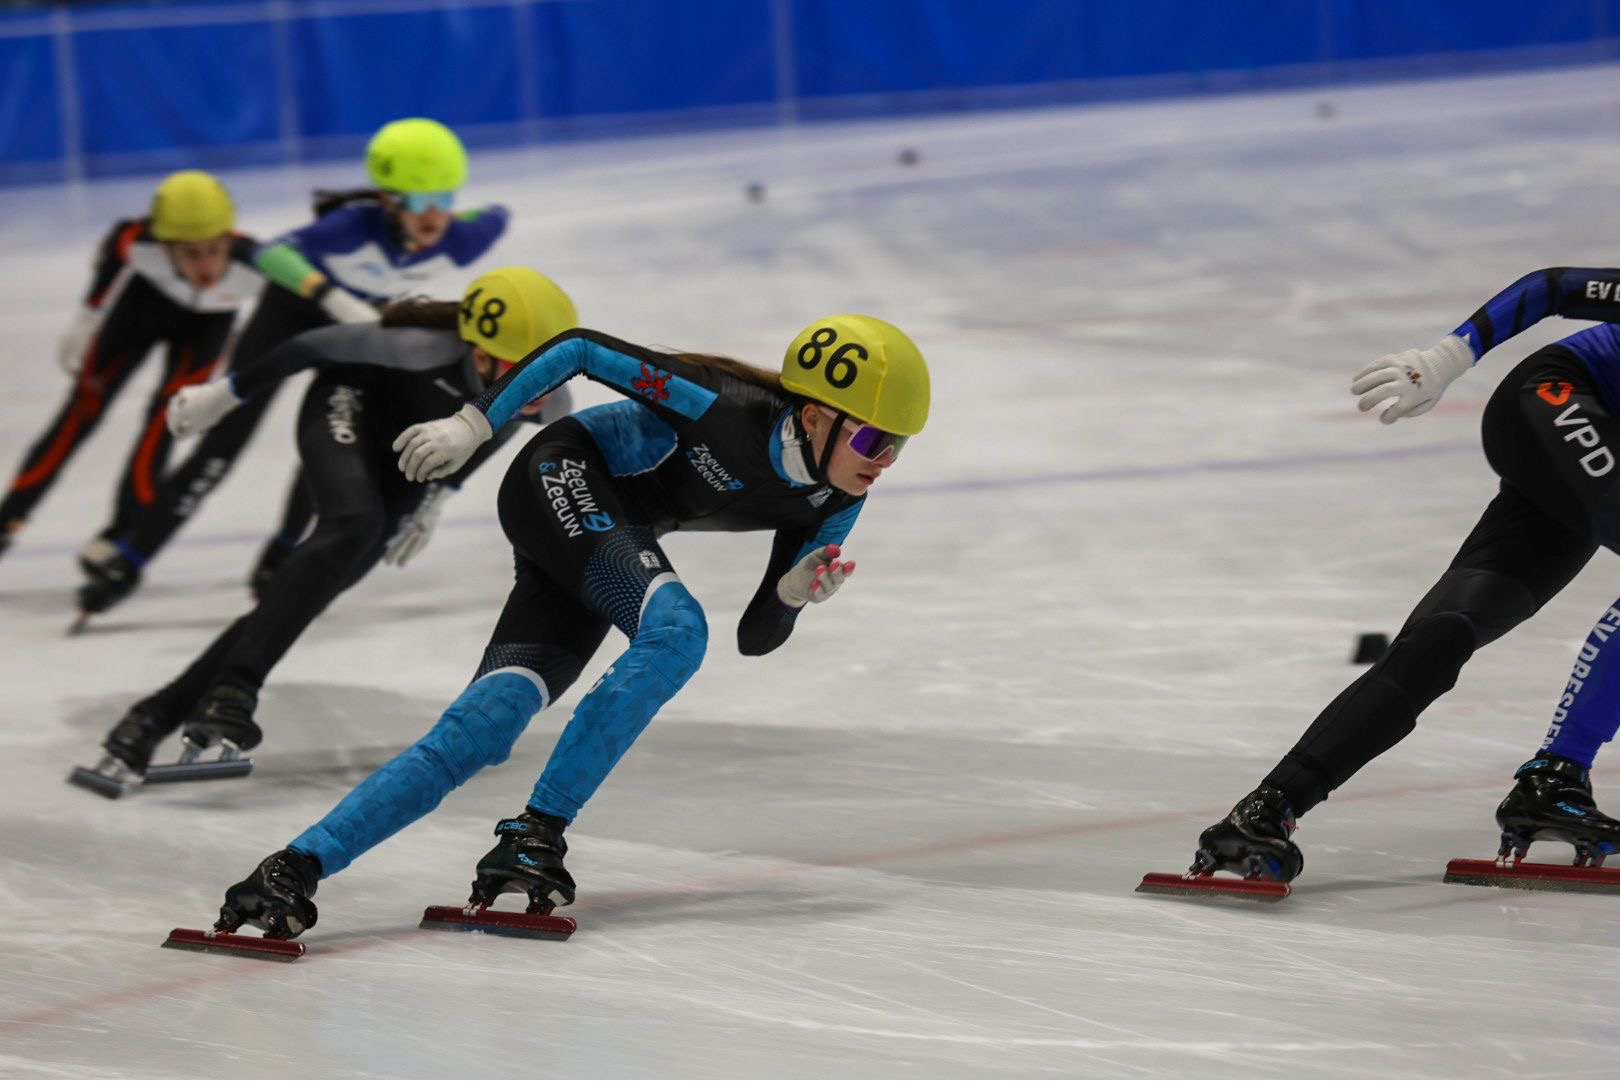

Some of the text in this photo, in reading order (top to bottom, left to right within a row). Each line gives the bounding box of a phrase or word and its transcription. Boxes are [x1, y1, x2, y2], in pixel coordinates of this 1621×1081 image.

[460, 287, 506, 339] 48
[1585, 280, 1613, 300] EV
[797, 327, 869, 389] 86
[692, 443, 732, 482] Zeeuw
[1553, 402, 1616, 478] VPD
[539, 461, 583, 538] & Zeeuw
[562, 457, 599, 513] Zeeuw
[690, 457, 727, 492] Zeeuw
[1592, 606, 1620, 643] EV
[1541, 641, 1600, 750] DRESDEN
